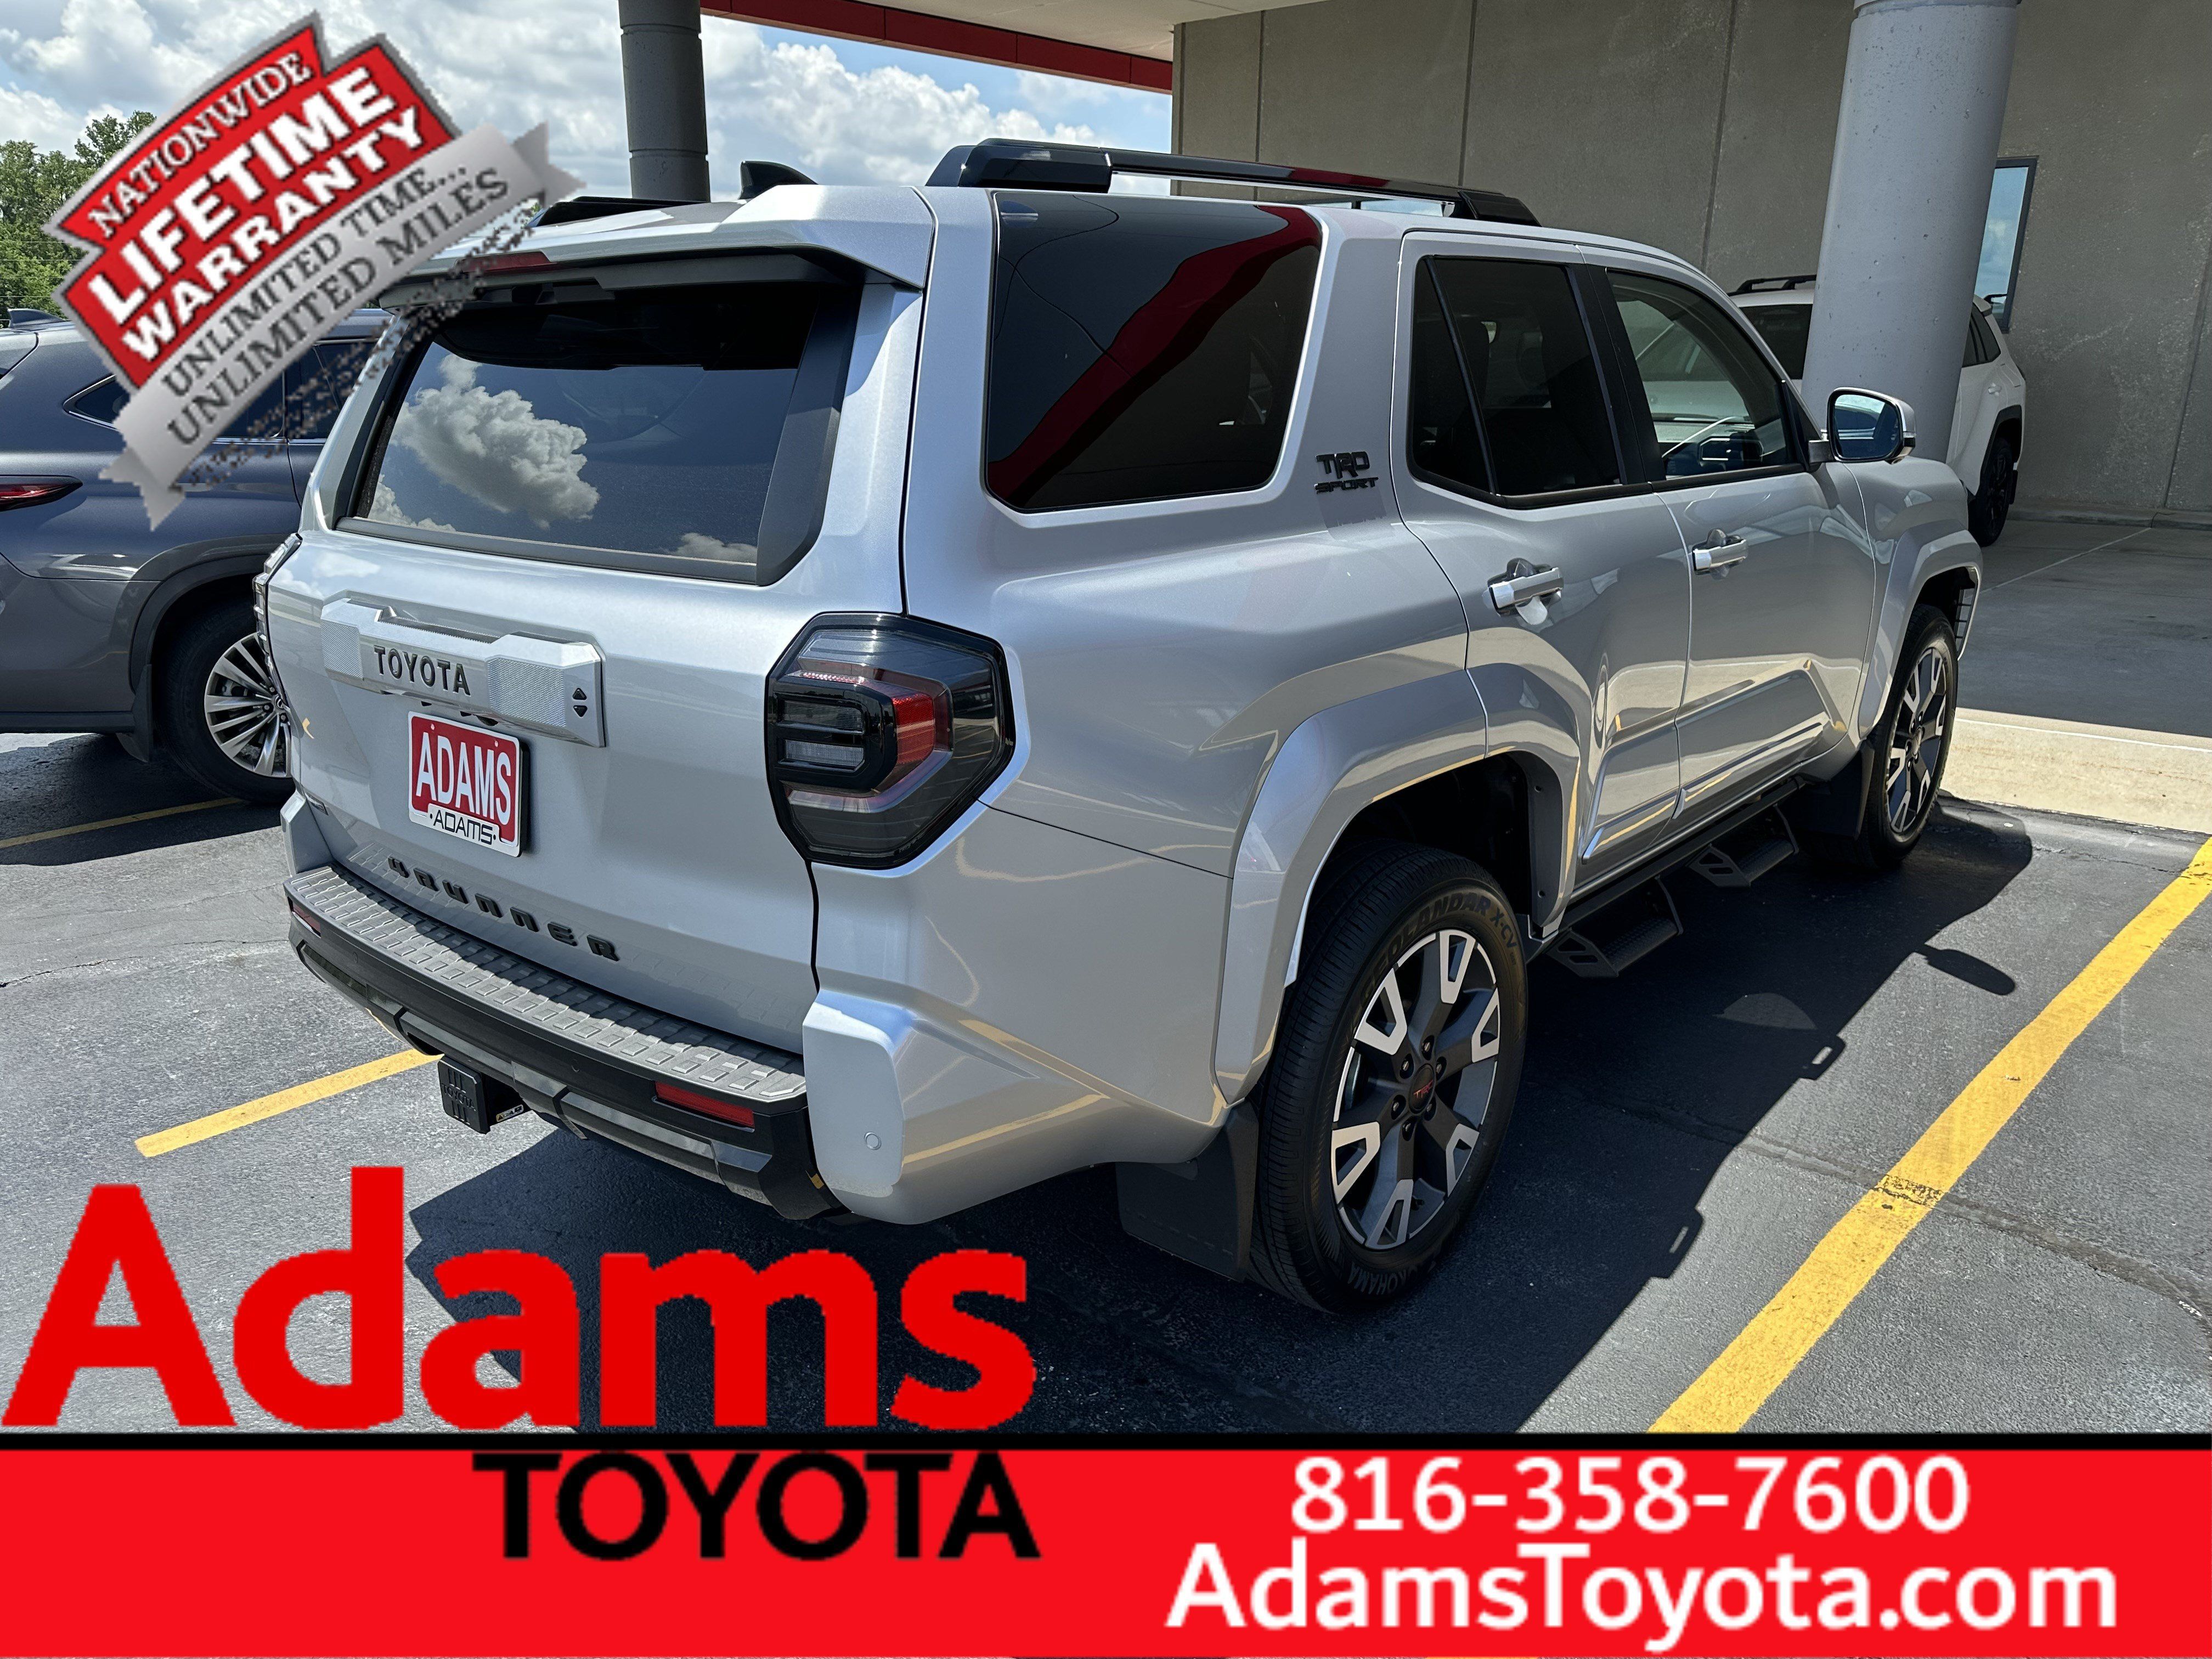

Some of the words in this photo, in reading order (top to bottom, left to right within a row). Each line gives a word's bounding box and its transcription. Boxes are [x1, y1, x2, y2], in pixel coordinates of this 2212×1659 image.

[1316, 451, 1370, 479] TRD
[1314, 477, 1379, 494] SPORT
[374, 645, 471, 696] TOYOTA
[416, 732, 511, 825] ADAMS
[433, 809, 493, 845] ADAMS
[388, 856, 619, 962] 4RUNNER
[441, 1083, 475, 1109] TOYOTA
